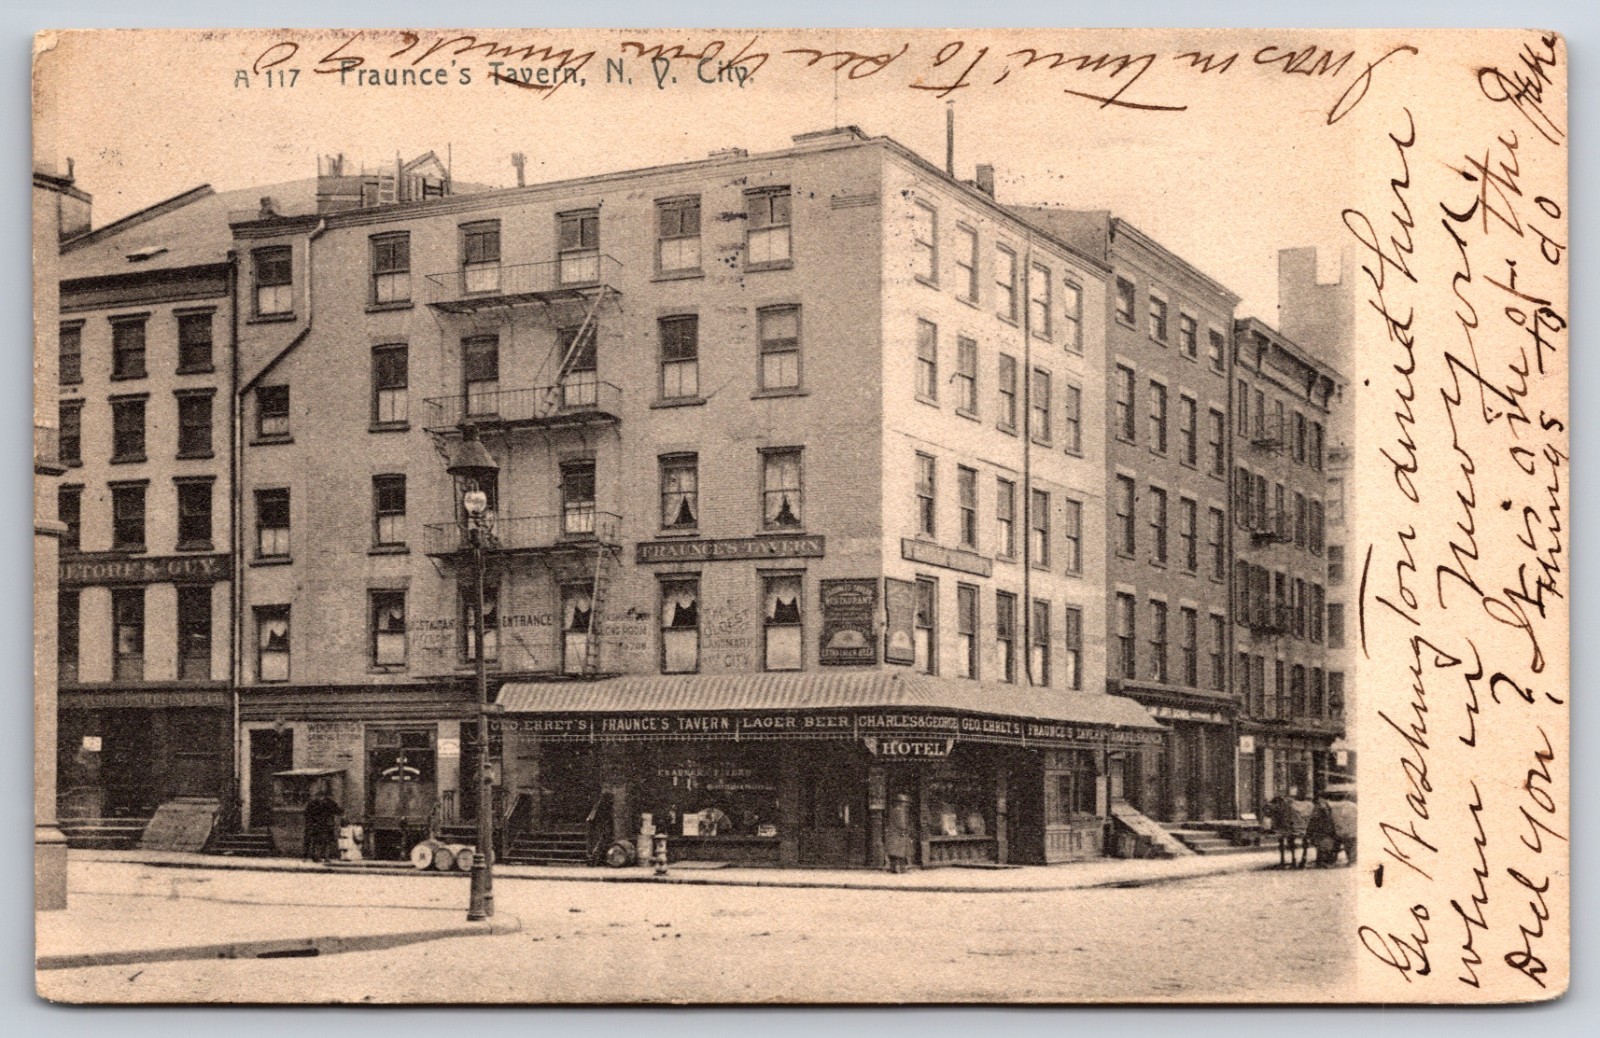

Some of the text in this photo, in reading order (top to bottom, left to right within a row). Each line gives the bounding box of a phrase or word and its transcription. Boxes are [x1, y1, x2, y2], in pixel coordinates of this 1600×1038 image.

[234, 57, 755, 91] A 117 Fraunce's Tavern, N. Y. City.
[784, 44, 908, 80] see
[1251, 44, 1354, 80] was
[1342, 108, 1416, 288] here
[1464, 130, 1524, 238] the
[1527, 197, 1566, 265] do
[1526, 307, 1566, 374] to
[1501, 508, 1536, 550] is
[502, 614, 553, 628] ENTRANCE
[601, 717, 670, 731] FRAUNCE'S
[678, 717, 730, 731] TAVERN
[742, 716, 796, 728] LAGER
[804, 715, 848, 727] BEER
[1359, 524, 1462, 880] Washington
[1451, 638, 1482, 746] in
[882, 742, 945, 756] HOTEL
[1451, 781, 1489, 988] when
[1504, 868, 1550, 989] Did
